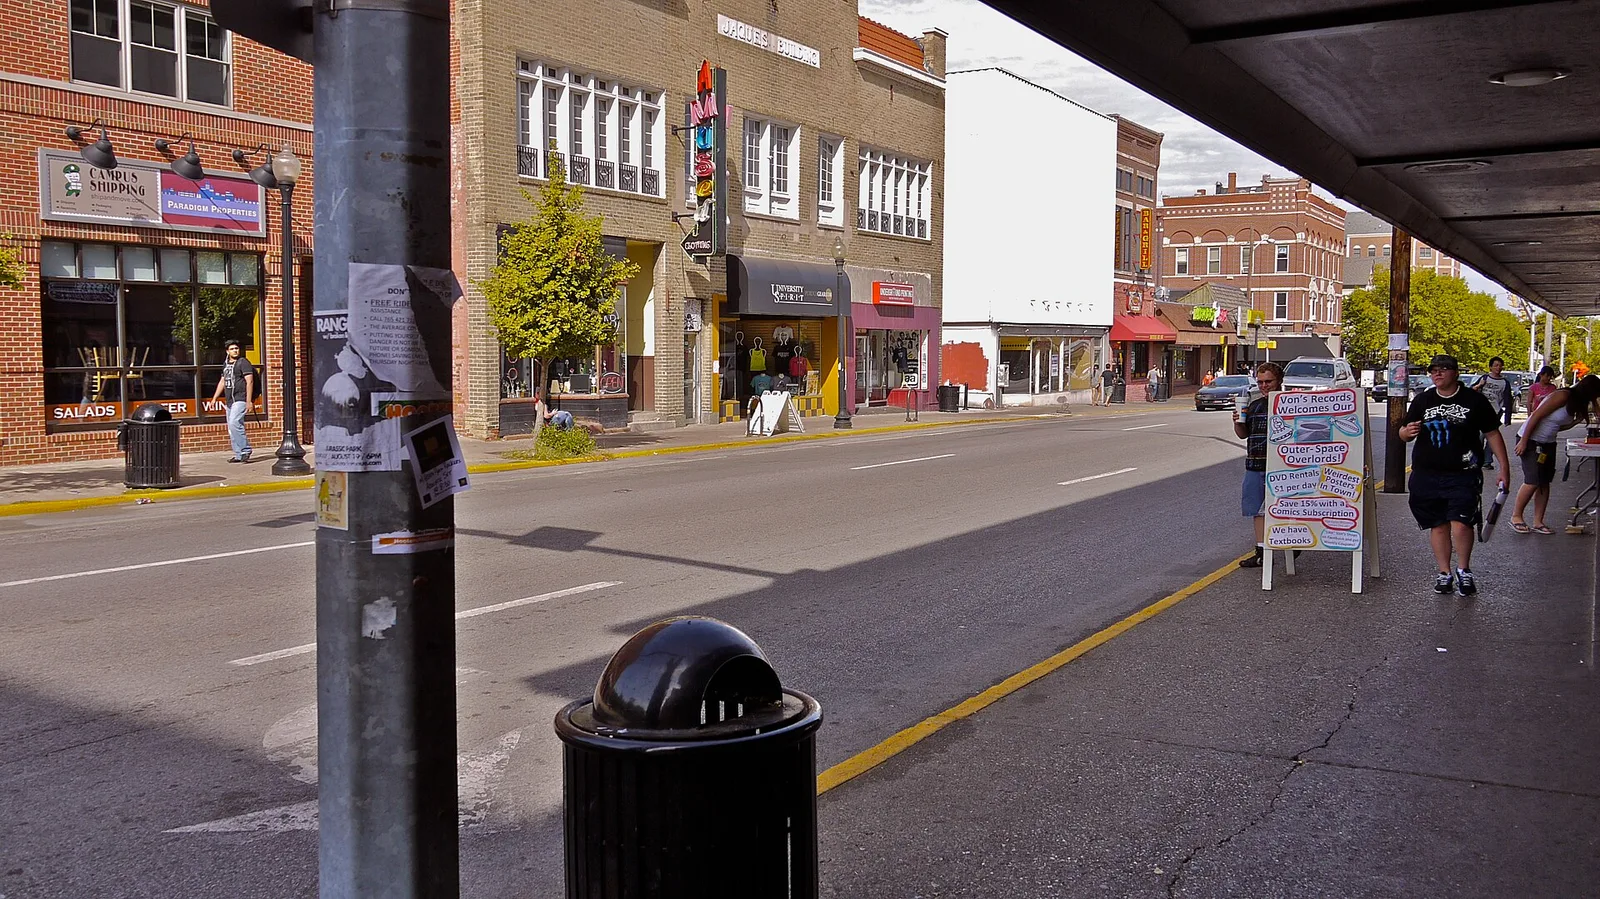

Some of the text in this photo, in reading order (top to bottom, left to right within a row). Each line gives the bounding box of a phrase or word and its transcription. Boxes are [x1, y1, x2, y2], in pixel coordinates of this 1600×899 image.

[90, 168, 138, 183] CAMPUS
[90, 180, 145, 197] SHIPPING
[168, 201, 257, 217] PARADIGM PROPERTIES
[684, 240, 712, 250] CLOTHING
[771, 283, 804, 295] UNIVERSITY
[371, 299, 392, 307] FREE
[600, 375, 624, 389] OPEN
[1280, 393, 1352, 404] Von's Records
[53, 405, 116, 419] SALADS
[1278, 403, 1353, 414] Welcomes Our
[1281, 444, 1346, 455] Outer- Space
[366, 452, 382, 460] 6PM
[1287, 453, 1341, 464] Overlords!
[1269, 470, 1320, 482] DVD Rentals
[1324, 467, 1360, 484] Weirdest
[1274, 482, 1317, 493] $1 per day
[1325, 475, 1355, 490] Posters
[1330, 486, 1356, 499] Town!
[1279, 500, 1299, 508] Save
[1271, 507, 1354, 519] Comics Subscription
[1272, 526, 1308, 534] We have
[1269, 537, 1311, 546] Textbooks
